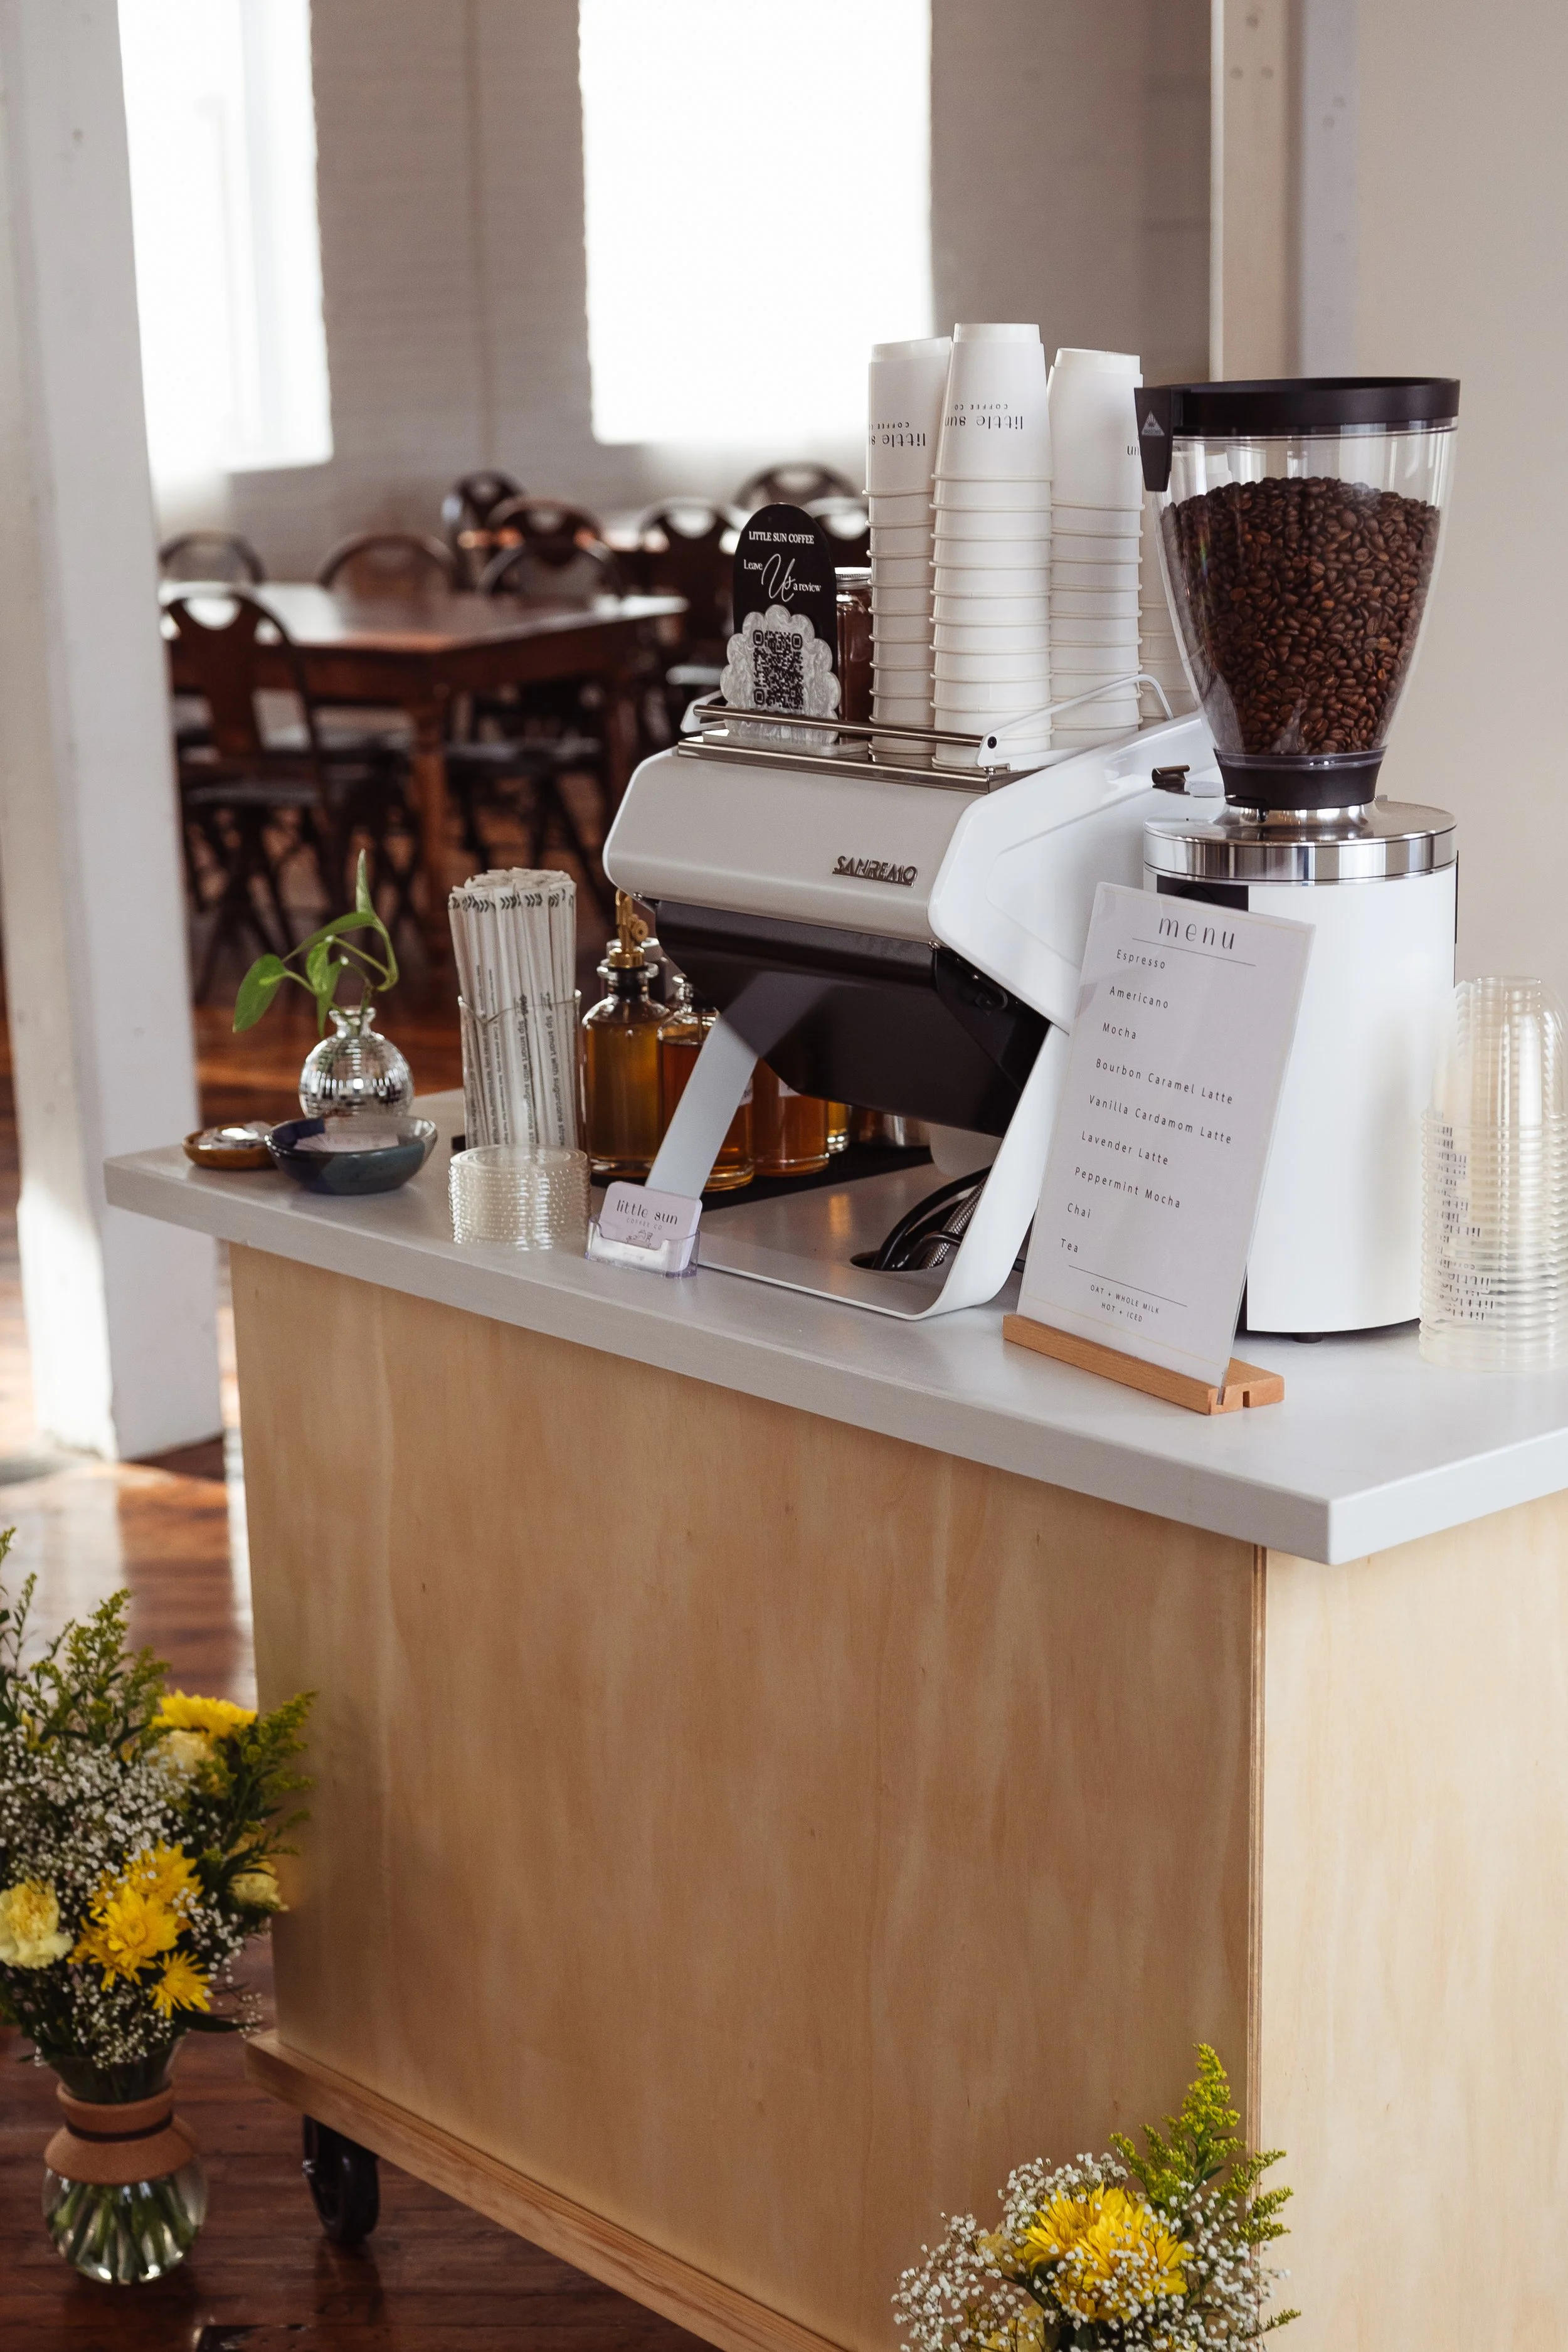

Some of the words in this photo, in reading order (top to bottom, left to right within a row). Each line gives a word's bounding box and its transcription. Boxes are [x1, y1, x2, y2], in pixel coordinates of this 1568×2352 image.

[945, 416, 966, 427] sun
[976, 416, 1024, 430] little
[882, 433, 926, 448] little
[1127, 445, 1140, 456] un
[749, 531, 771, 541] LITTLE
[773, 532, 787, 542] SUN
[788, 534, 814, 544] COFFEE
[744, 559, 762, 570] Leave
[793, 583, 798, 591] a
[799, 583, 821, 592] review
[833, 856, 918, 887] SANREMO
[1159, 918, 1234, 949] menu
[1116, 950, 1167, 969] Espresso
[1110, 986, 1168, 1009] Americano
[1103, 1022, 1136, 1039] Mocha
[1096, 1059, 1140, 1079] Bourbon
[1148, 1073, 1194, 1094] Caramel
[1202, 1088, 1232, 1104] Latte
[1090, 1094, 1128, 1114] Vanilla
[1135, 1108, 1192, 1133] Cardamom
[1200, 1127, 1231, 1143] Latte
[1082, 1131, 1131, 1153] Lavender
[1139, 1148, 1167, 1165] Latte
[1075, 1167, 1138, 1195] Peppermint
[1145, 1189, 1180, 1208] Mocha
[616, 1199, 649, 1218] little
[655, 1212, 677, 1224] sun
[1067, 1203, 1090, 1218] Chai
[1061, 1239, 1078, 1253] Tea
[1090, 1284, 1104, 1295] OAT
[1115, 1293, 1139, 1307] WHOLE
[1142, 1303, 1159, 1314] MILK
[1101, 1302, 1116, 1312] HOT
[1126, 1311, 1143, 1322] ICED
